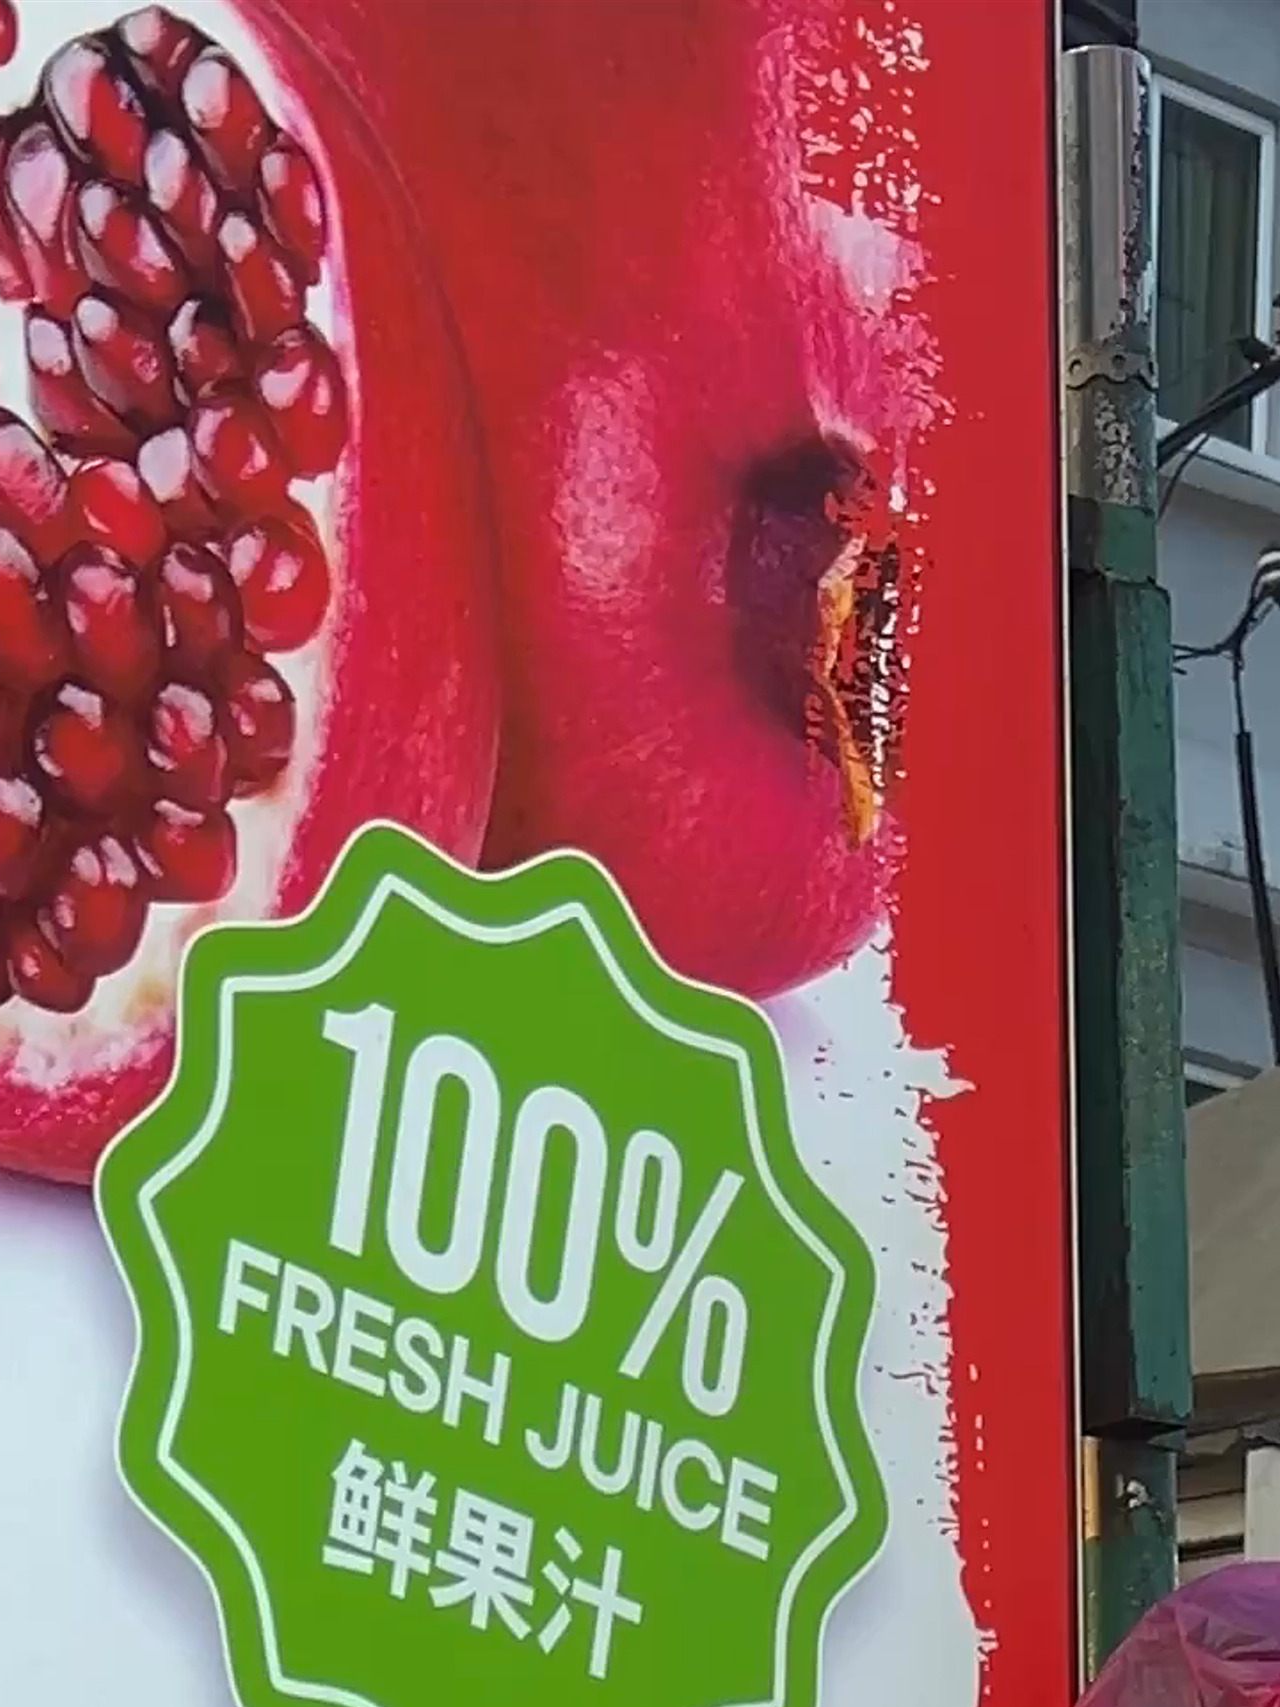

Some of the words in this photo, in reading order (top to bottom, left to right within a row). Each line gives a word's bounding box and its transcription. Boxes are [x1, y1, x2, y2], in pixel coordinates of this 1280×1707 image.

[322, 1002, 748, 1417] 100%
[218, 1238, 512, 1446] FRESH
[525, 1382, 778, 1561] JUICE
[322, 1438, 642, 1679] 鲜果汁
